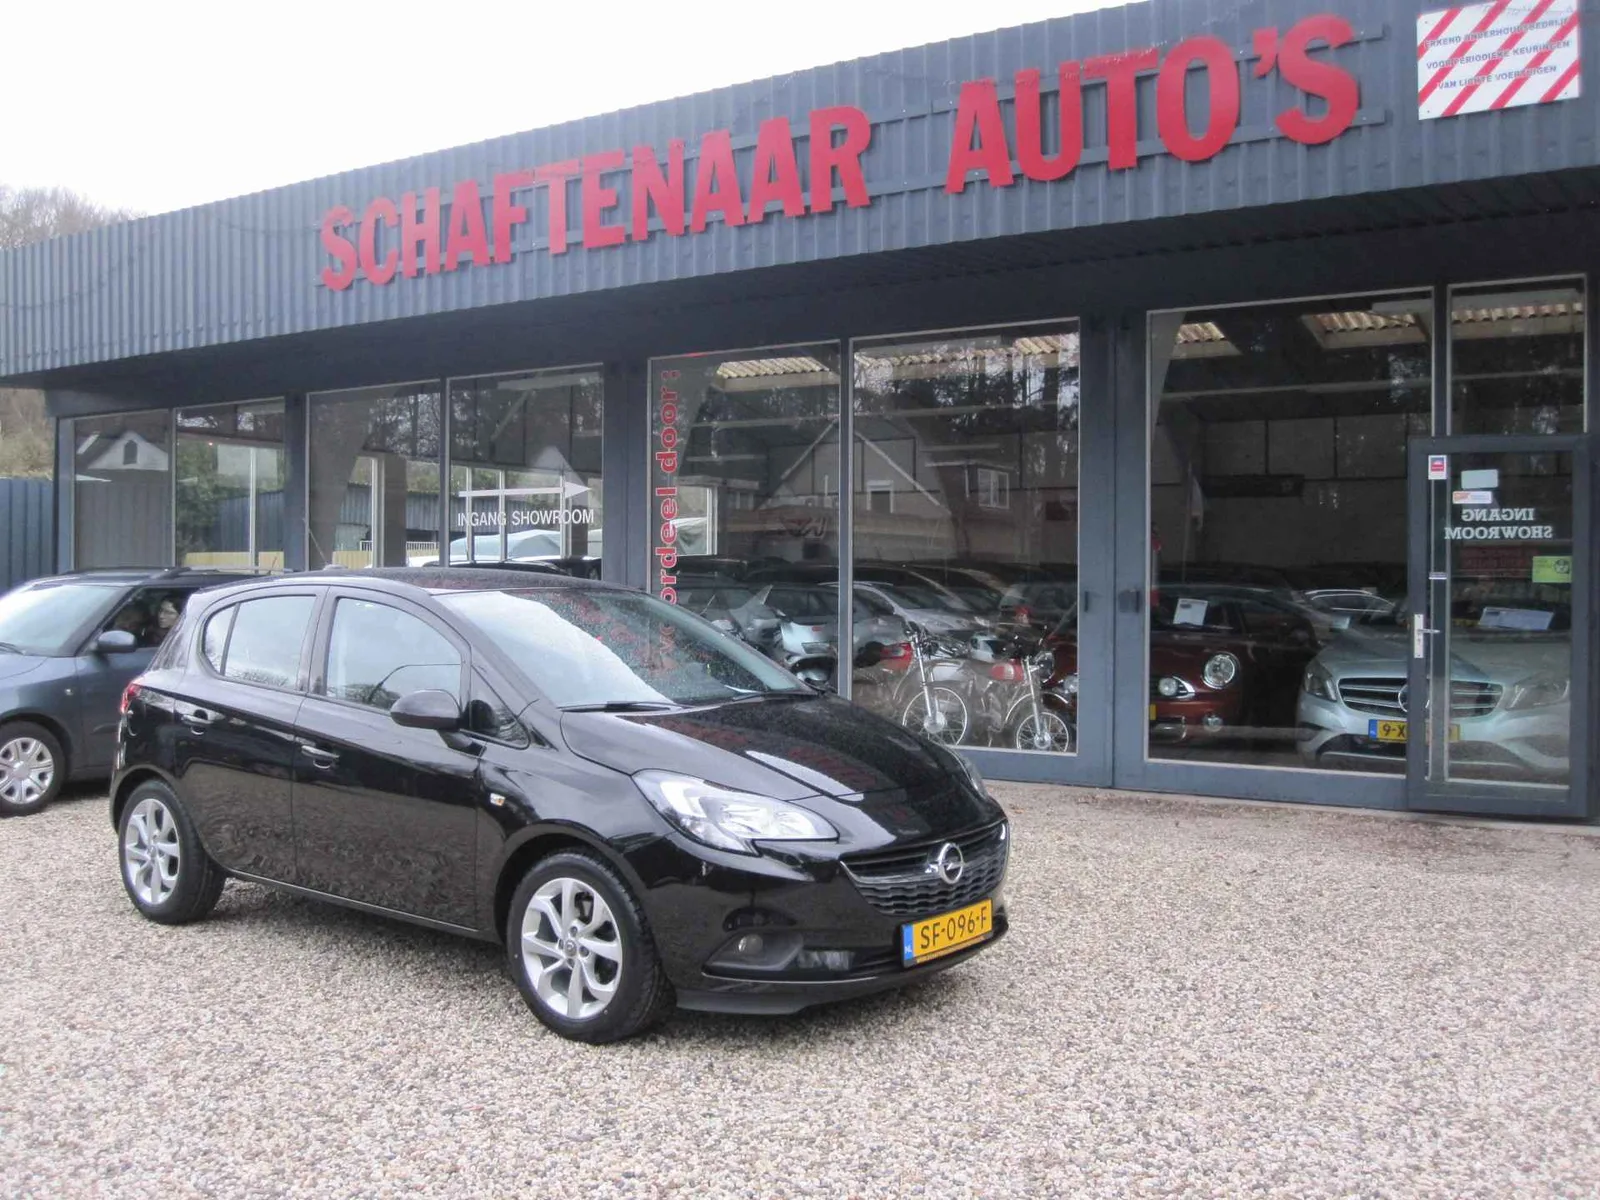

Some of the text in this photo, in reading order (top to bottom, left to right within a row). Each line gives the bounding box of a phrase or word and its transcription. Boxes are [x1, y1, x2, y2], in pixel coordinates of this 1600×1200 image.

[1424, 34, 1462, 48] ERKEND
[1426, 57, 1452, 70] VOOR
[1512, 40, 1570, 56] KEURINGEN
[1438, 80, 1457, 90] VAN
[321, 14, 1359, 292] SCHAFTENAAR AUTO'S
[457, 508, 595, 527] INGANG SHOWROOM
[920, 905, 988, 950] SF-096-F
